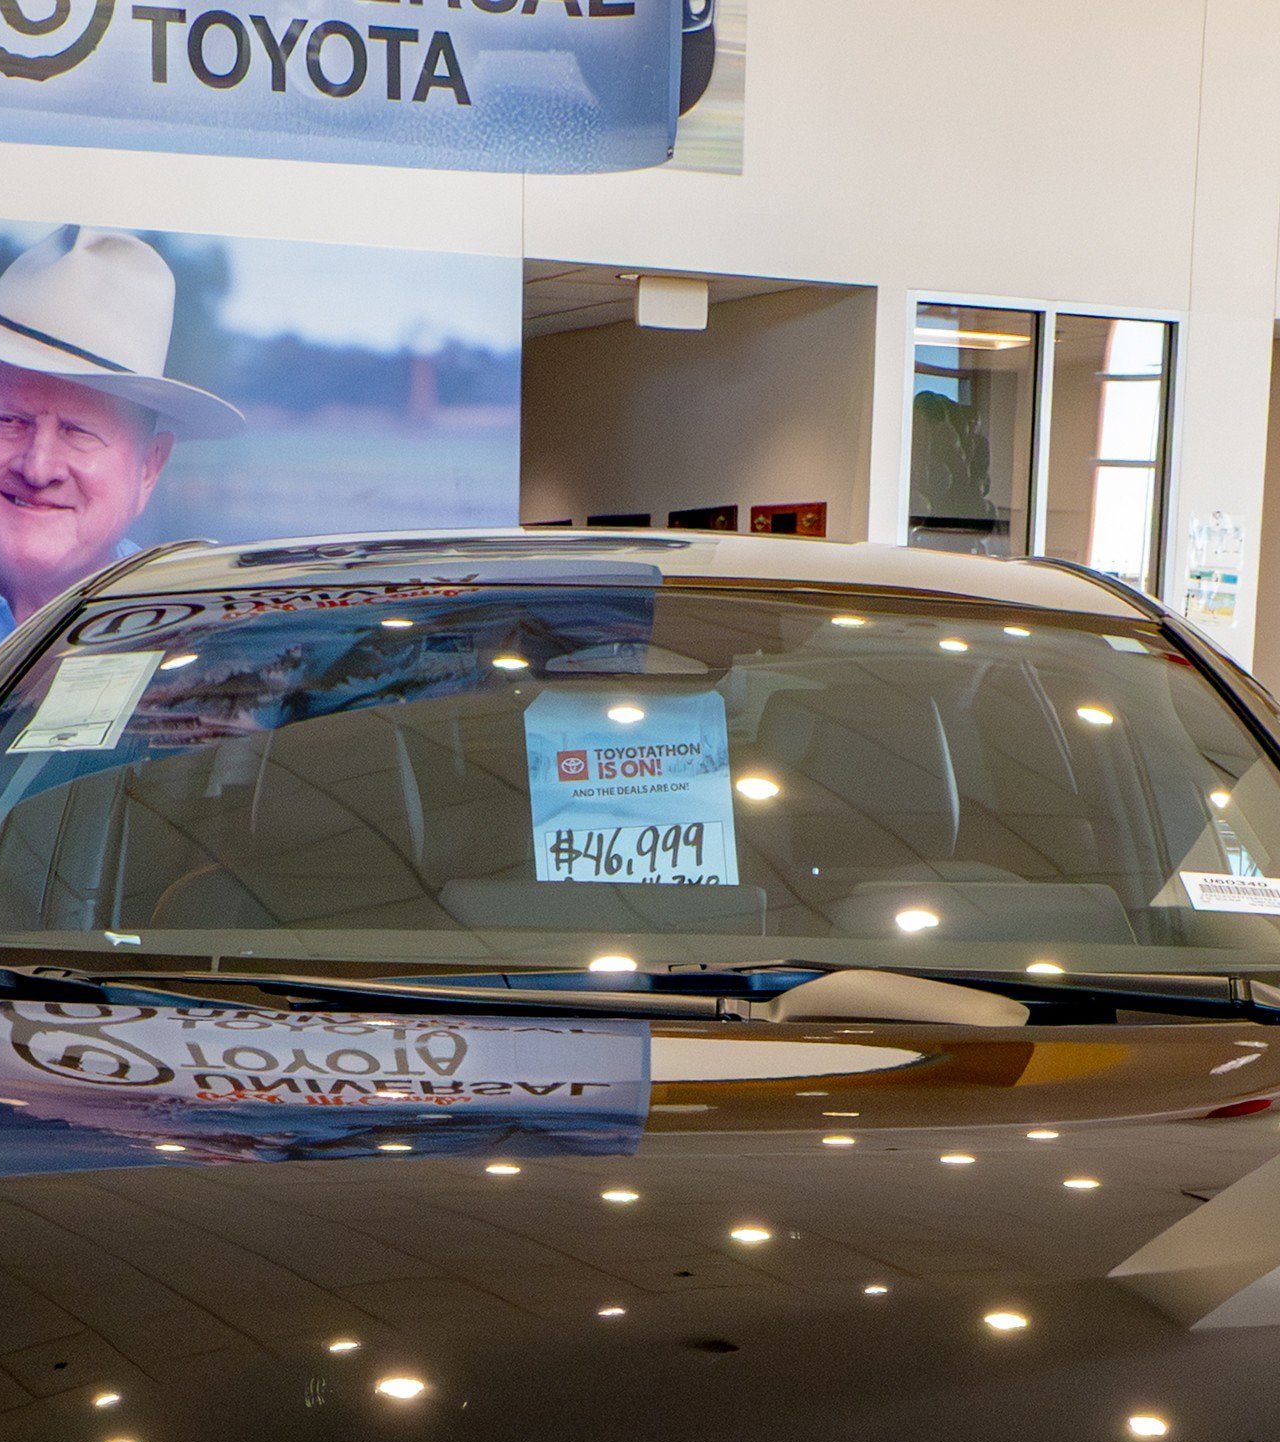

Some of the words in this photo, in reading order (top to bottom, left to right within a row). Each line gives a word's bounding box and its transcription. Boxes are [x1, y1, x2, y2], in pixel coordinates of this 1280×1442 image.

[131, 5, 471, 106] TOYOTA
[594, 743, 701, 761] TOYOTATHON
[598, 761, 617, 780] IS
[620, 759, 663, 779] ON!
[572, 787, 595, 798] AND
[596, 786, 615, 797] THE
[617, 785, 648, 795] DEALS
[649, 784, 669, 793] ARE
[670, 782, 690, 792] ON!
[549, 822, 704, 877] $46,999
